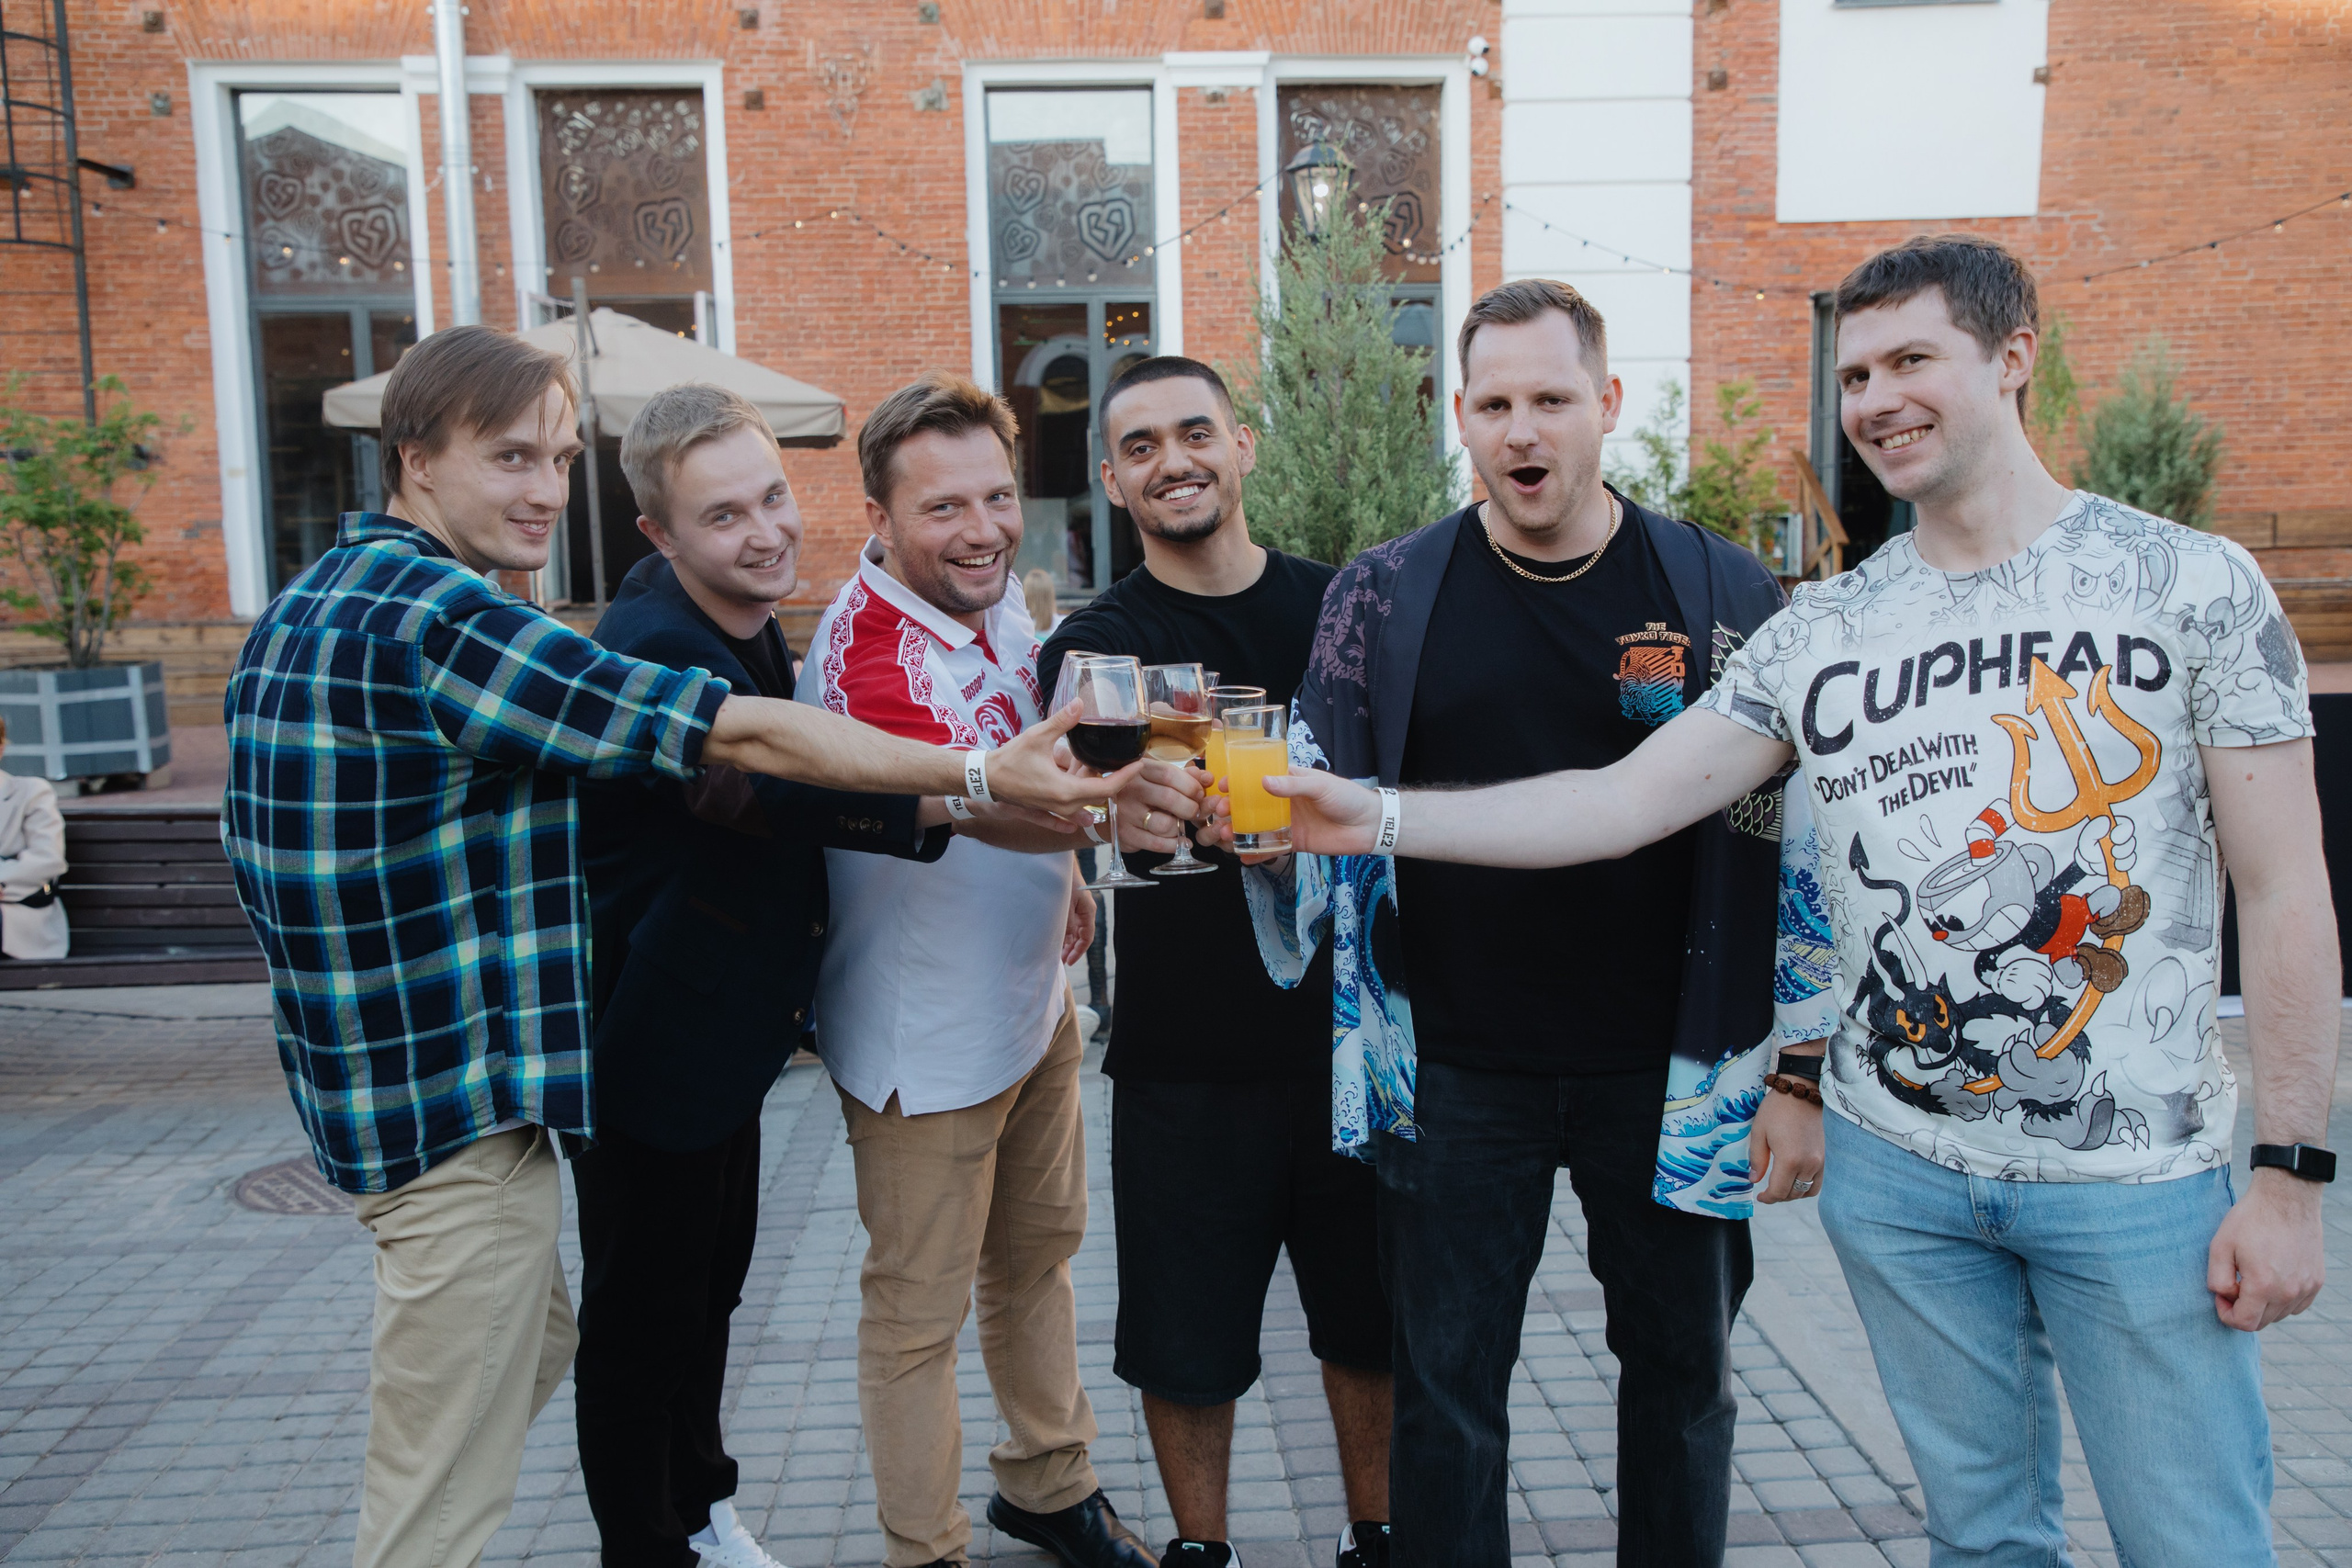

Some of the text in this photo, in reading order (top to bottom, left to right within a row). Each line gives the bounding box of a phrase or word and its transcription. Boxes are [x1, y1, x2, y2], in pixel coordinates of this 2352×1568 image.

[1645, 622, 1667, 631] THE
[1868, 742, 1925, 784] DEAL
[1917, 732, 1979, 761] WITH
[968, 767, 985, 795] TELE2
[1878, 787, 1910, 818] THE
[1380, 817, 1395, 847] TELE2
